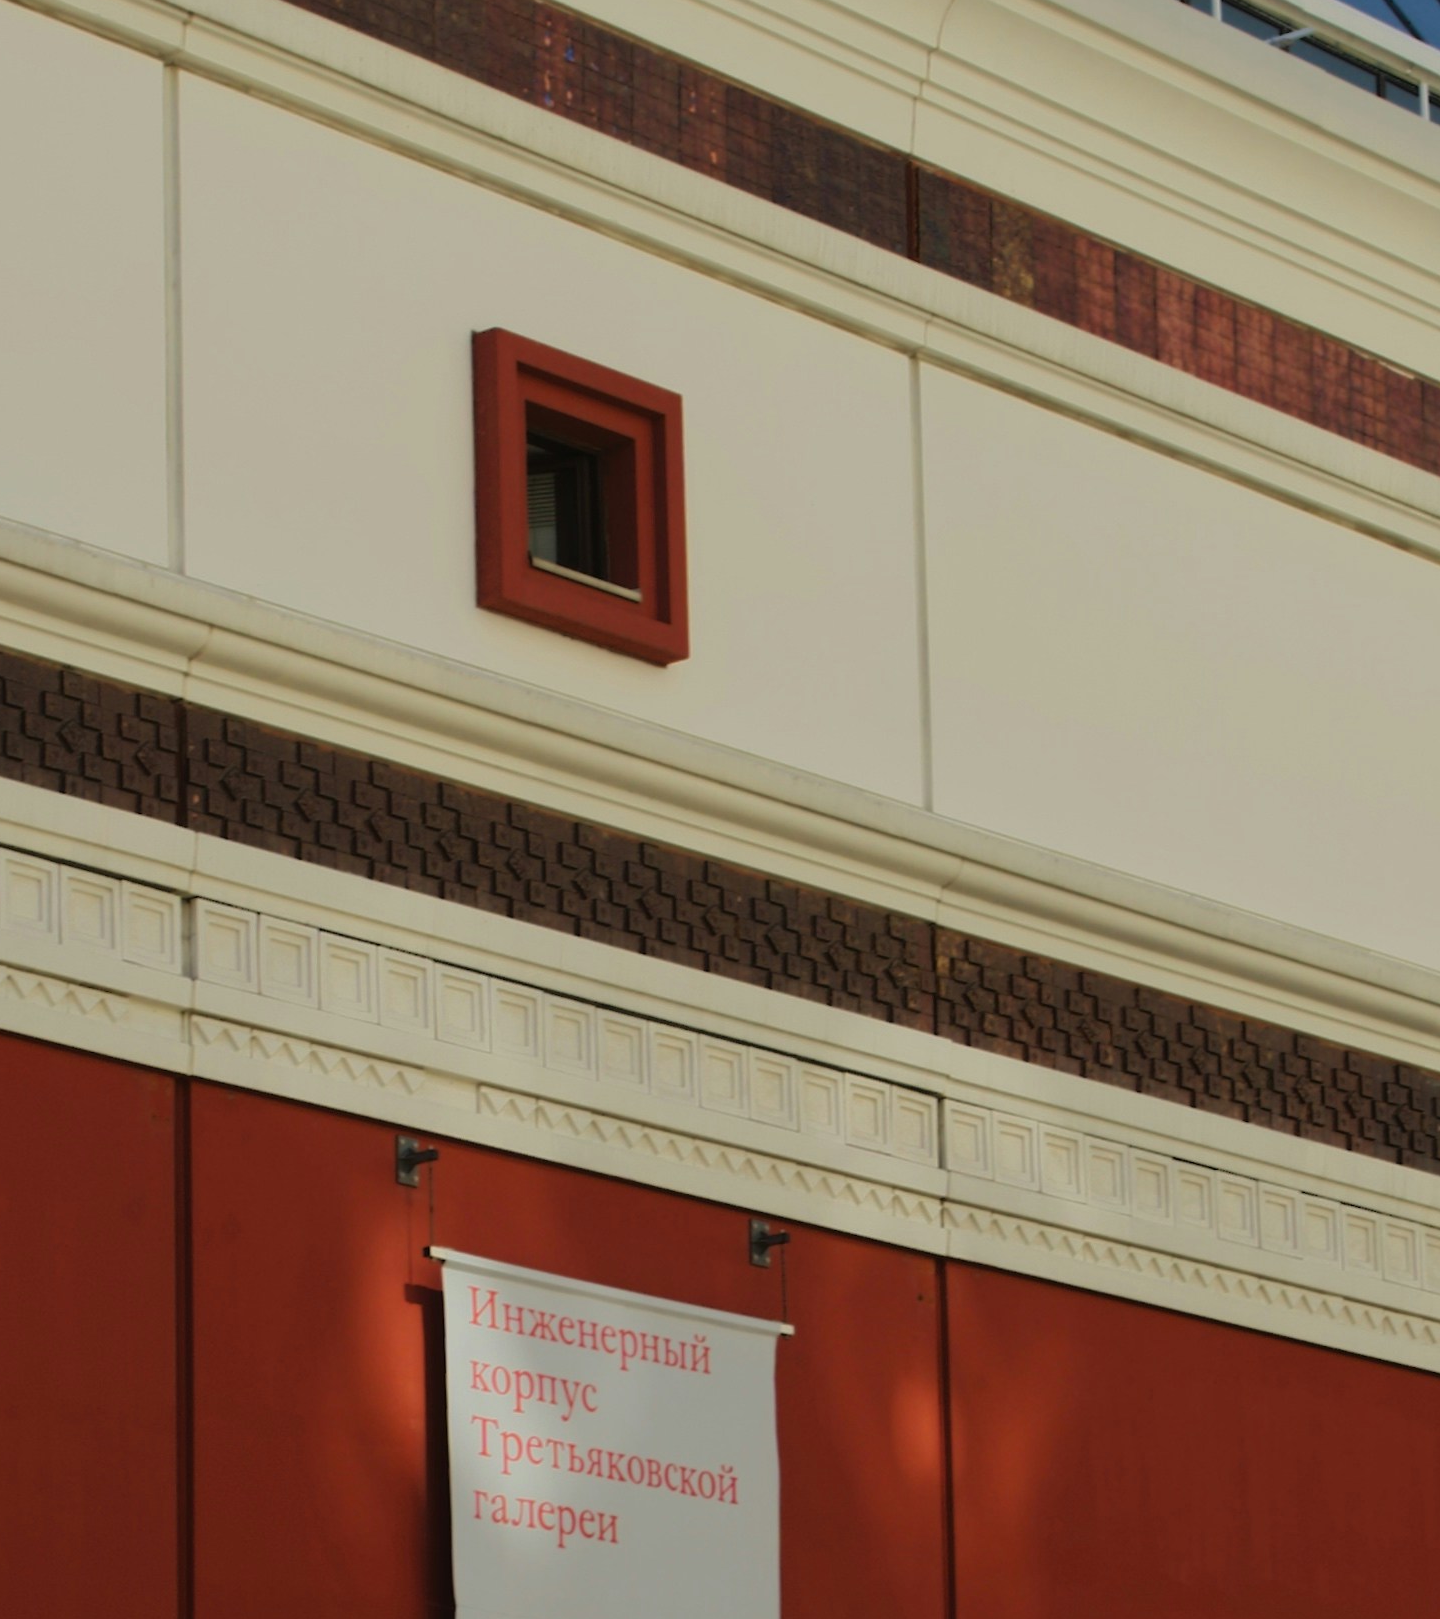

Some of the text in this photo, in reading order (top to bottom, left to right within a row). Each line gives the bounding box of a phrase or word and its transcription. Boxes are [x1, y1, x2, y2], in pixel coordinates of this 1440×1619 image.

[468, 1284, 712, 1375] Инженерный
[470, 1358, 598, 1423] корпус
[470, 1413, 739, 1506] Третьяковской
[472, 1488, 619, 1549] галереи
